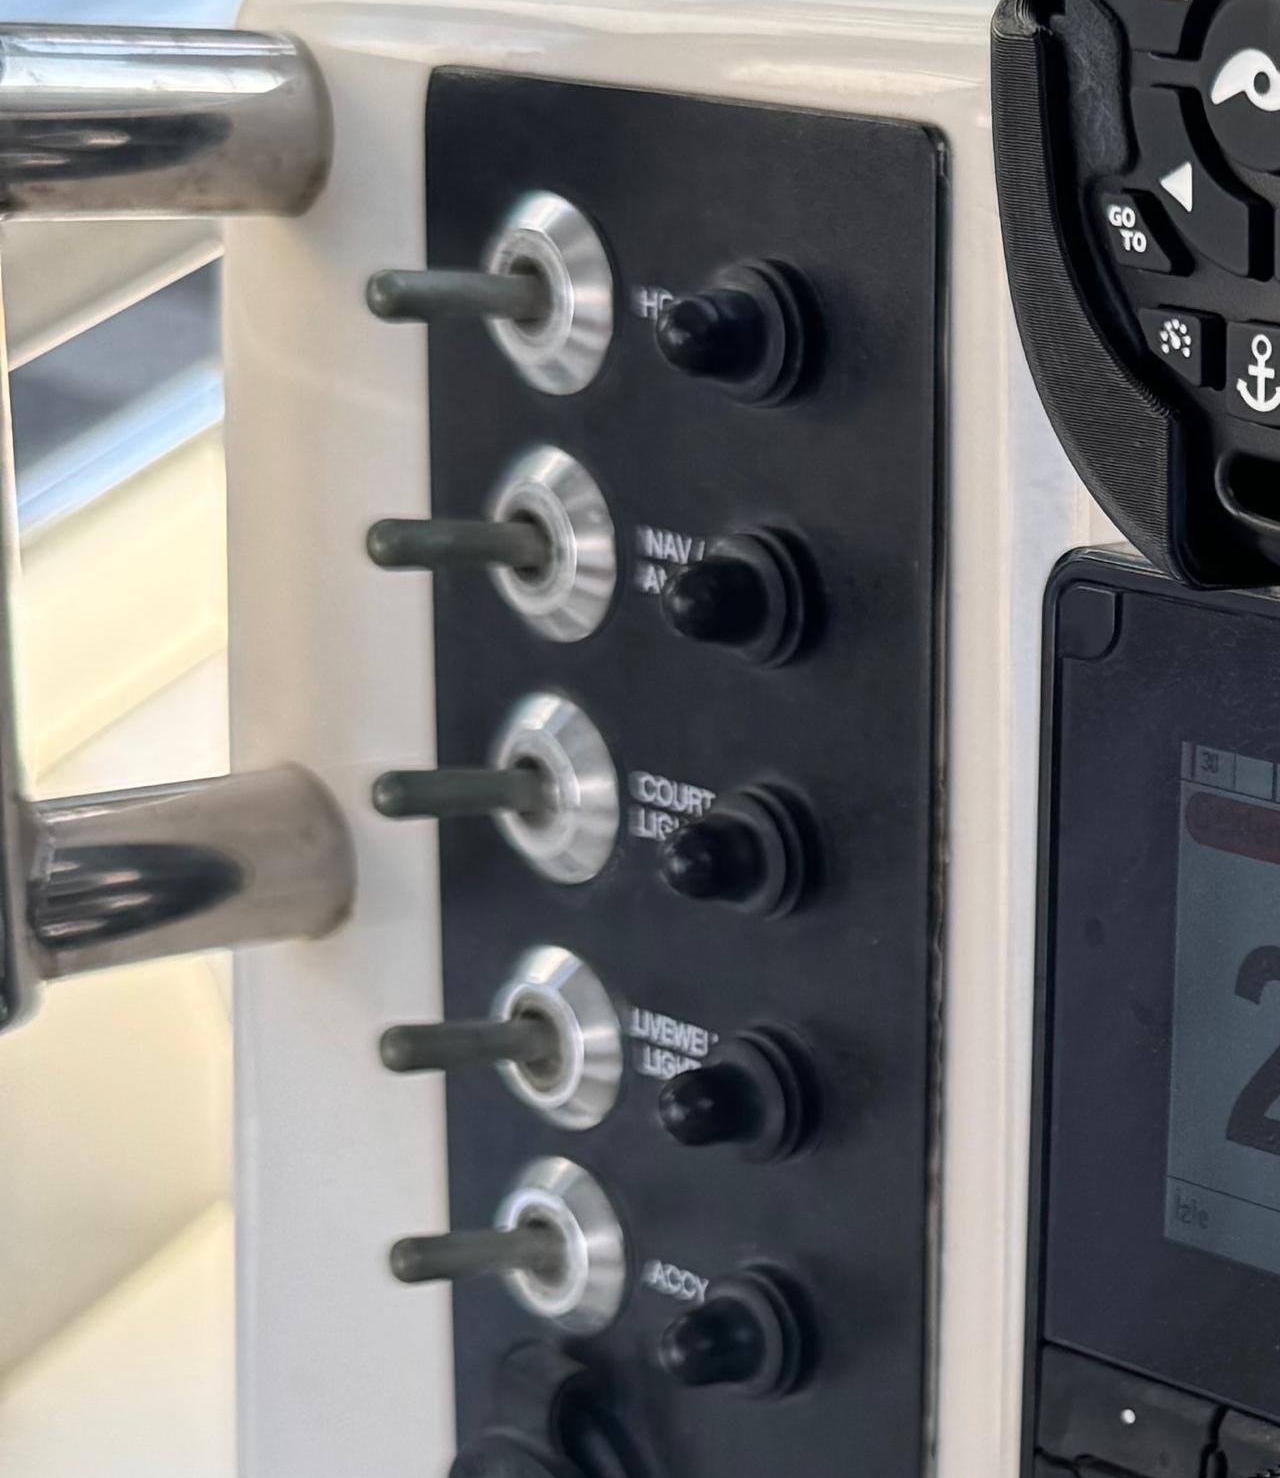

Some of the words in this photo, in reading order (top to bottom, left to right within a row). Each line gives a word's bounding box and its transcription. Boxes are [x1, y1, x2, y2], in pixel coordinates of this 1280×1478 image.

[1107, 204, 1136, 228] GO
[1121, 230, 1147, 253] TO
[647, 1259, 709, 1301] ACCY
